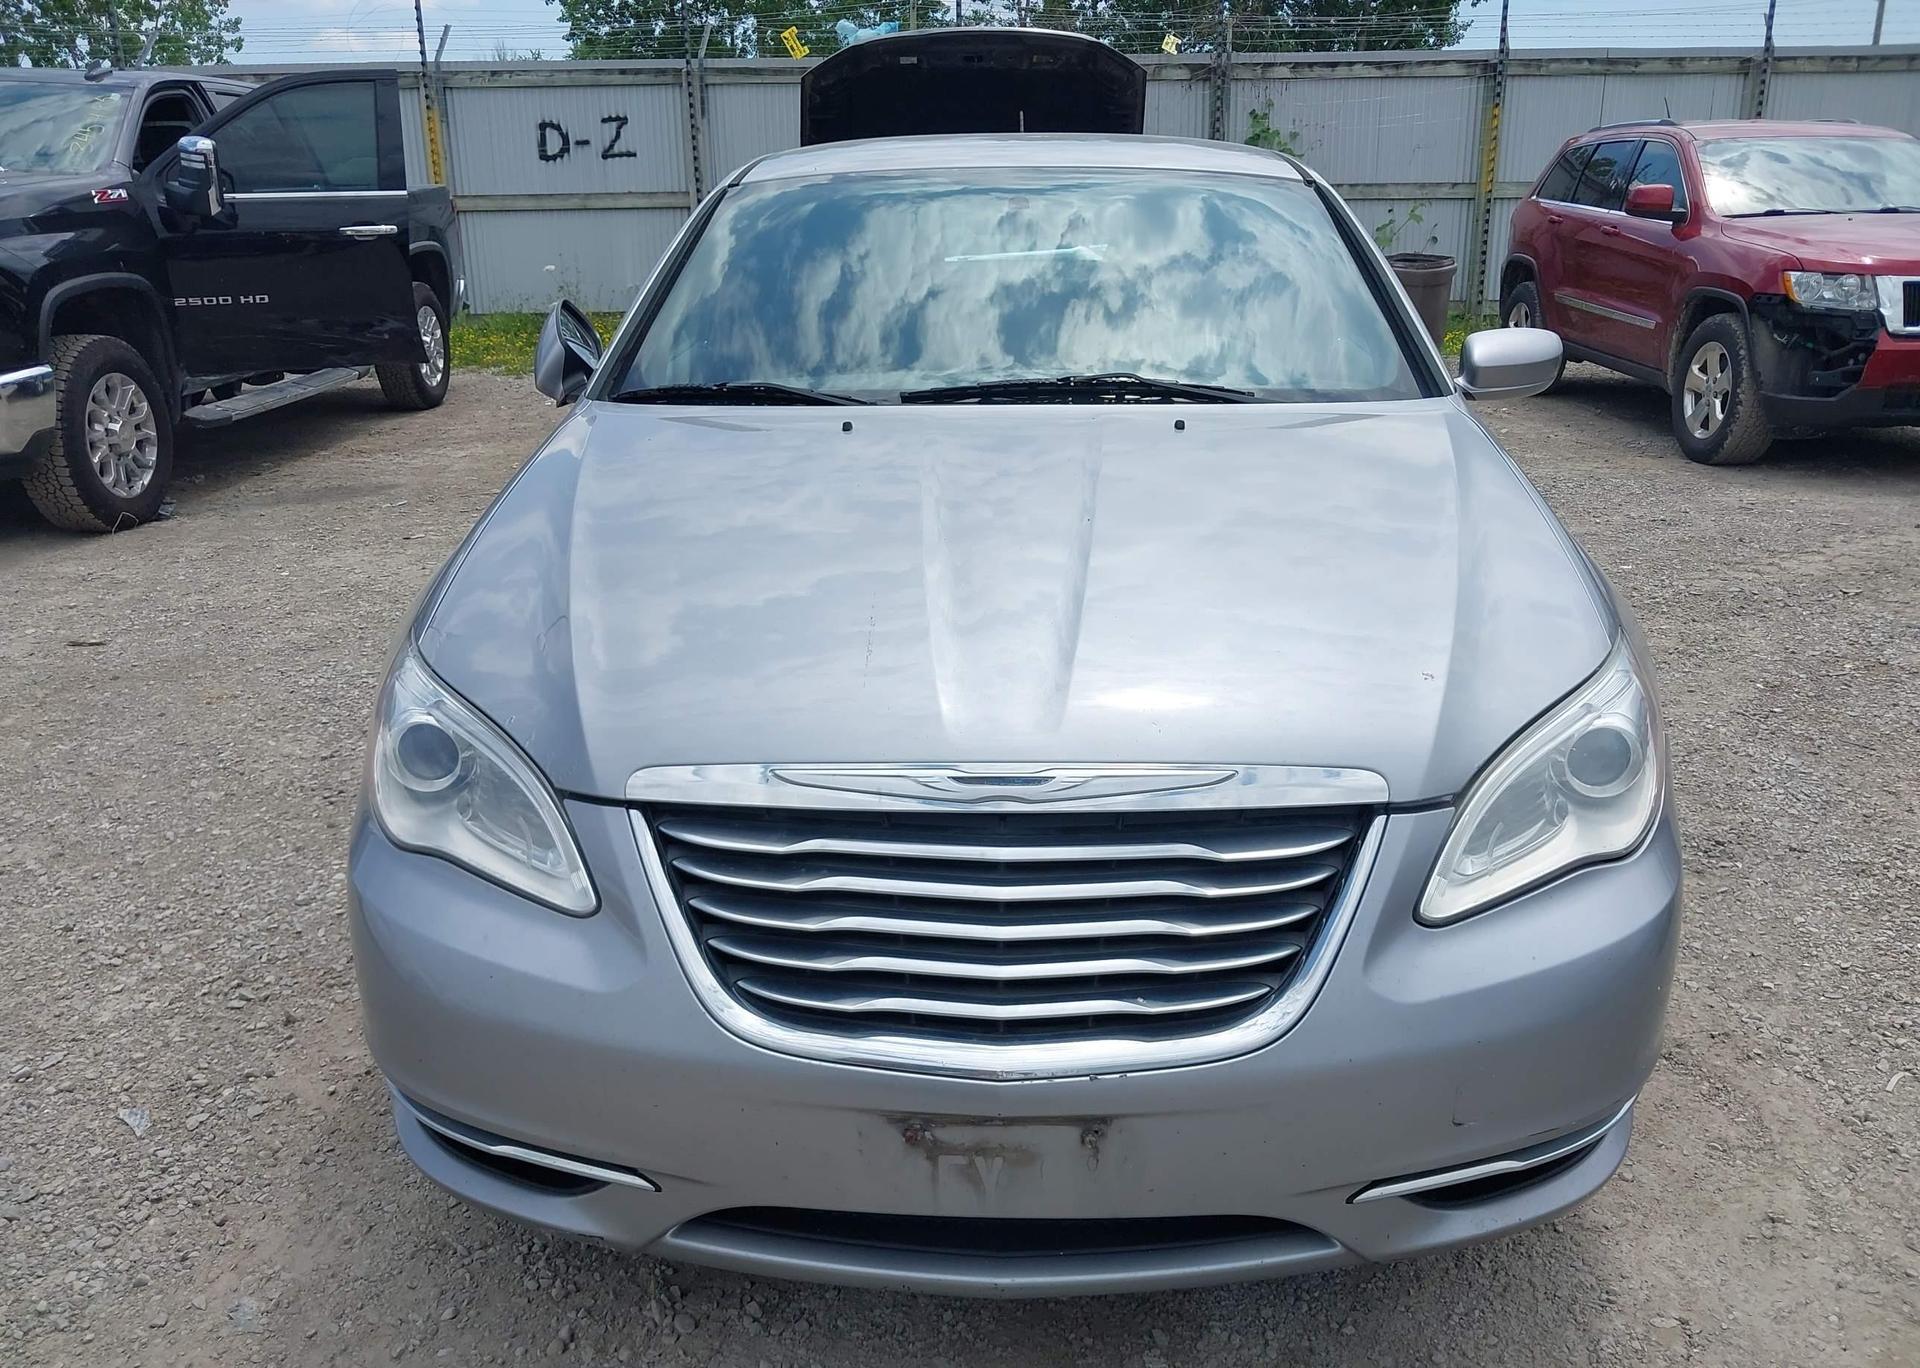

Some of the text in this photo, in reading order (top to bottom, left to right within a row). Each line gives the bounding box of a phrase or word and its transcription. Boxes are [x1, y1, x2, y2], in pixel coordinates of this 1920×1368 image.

[539, 116, 637, 161] D-Z
[174, 295, 269, 306] 2500 HD
